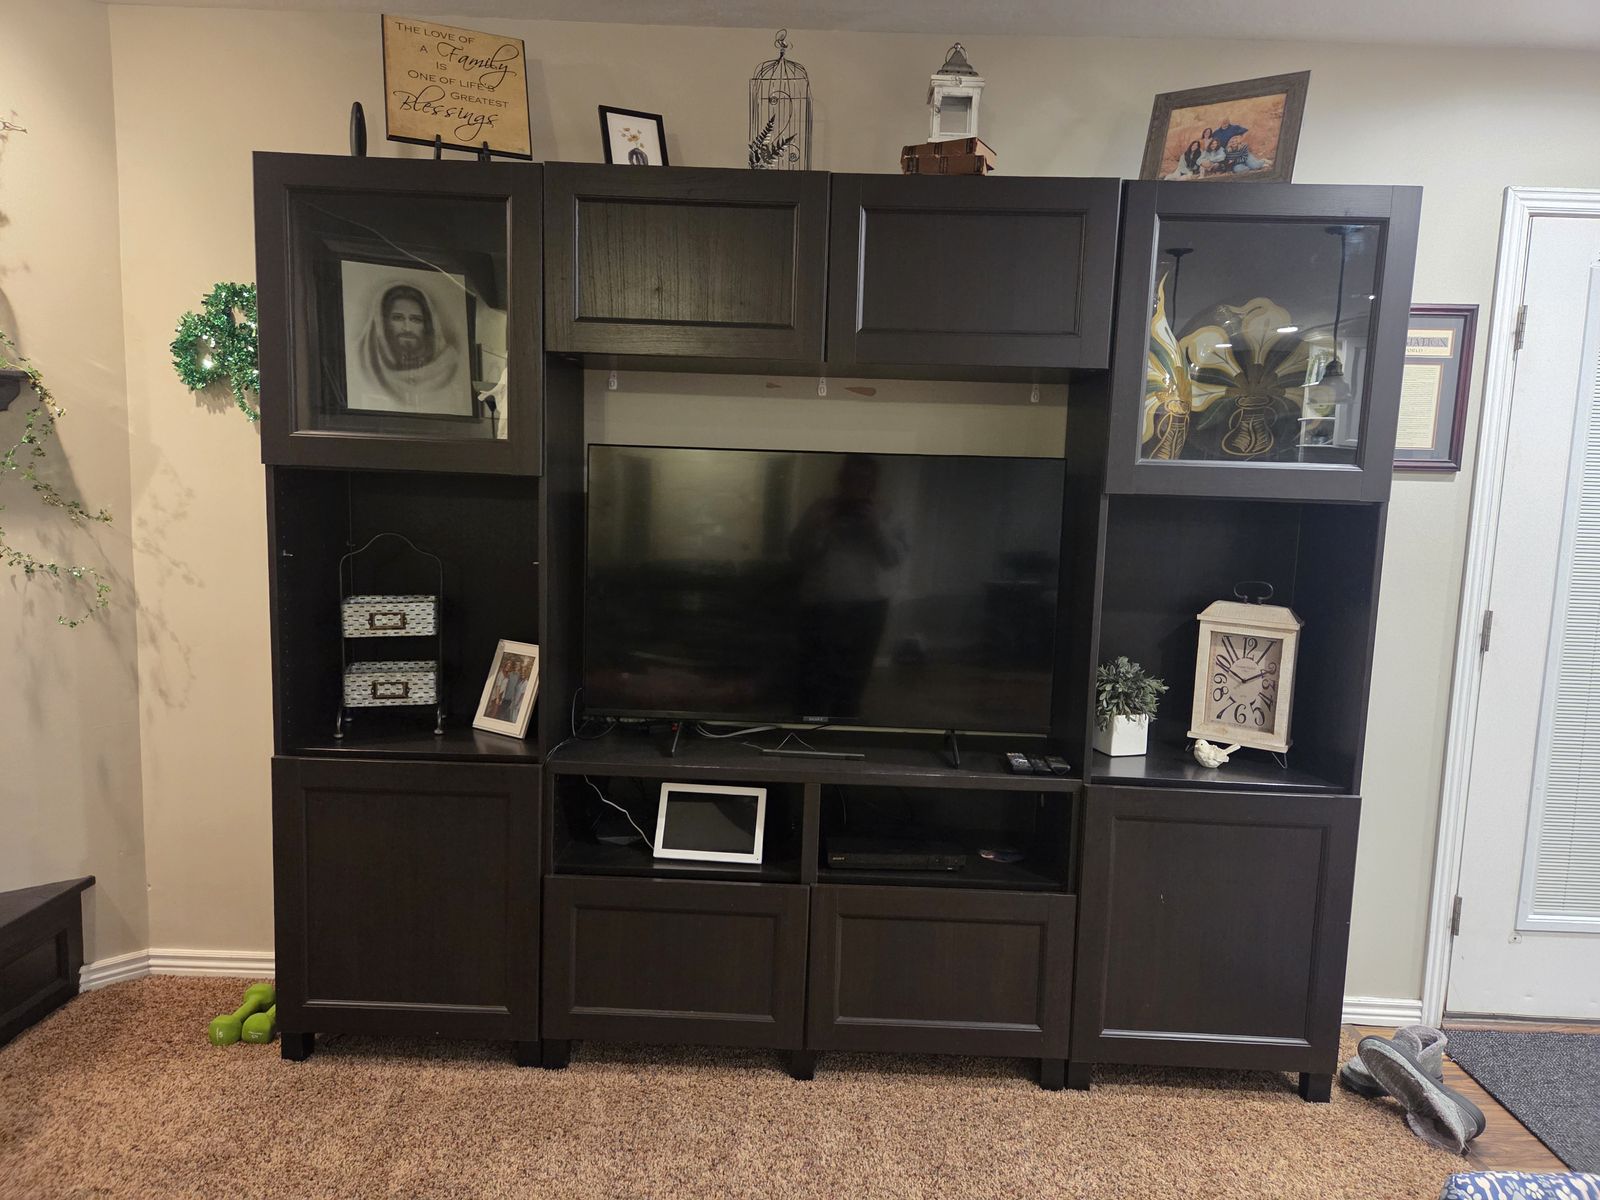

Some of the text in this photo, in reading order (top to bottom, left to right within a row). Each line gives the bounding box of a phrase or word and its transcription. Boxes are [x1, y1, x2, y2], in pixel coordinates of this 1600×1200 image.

[395, 21, 476, 45] THE LOVE OF
[419, 42, 519, 90] A Family
[435, 61, 447, 71] IS
[407, 69, 496, 93] ONE OF LIFE'S
[450, 91, 510, 109] GREATEST
[392, 84, 499, 142] Blessings
[1222, 635, 1241, 665] 11
[1241, 637, 1258, 660] 12
[1255, 640, 1278, 666] 1
[1215, 654, 1232, 674] 10
[1213, 672, 1228, 685] 9
[1261, 678, 1276, 692] 3
[1212, 685, 1229, 702] 8
[1257, 691, 1274, 713] 4
[1216, 695, 1236, 720] 7
[1233, 703, 1247, 724] 6
[1249, 699, 1266, 727] 5
